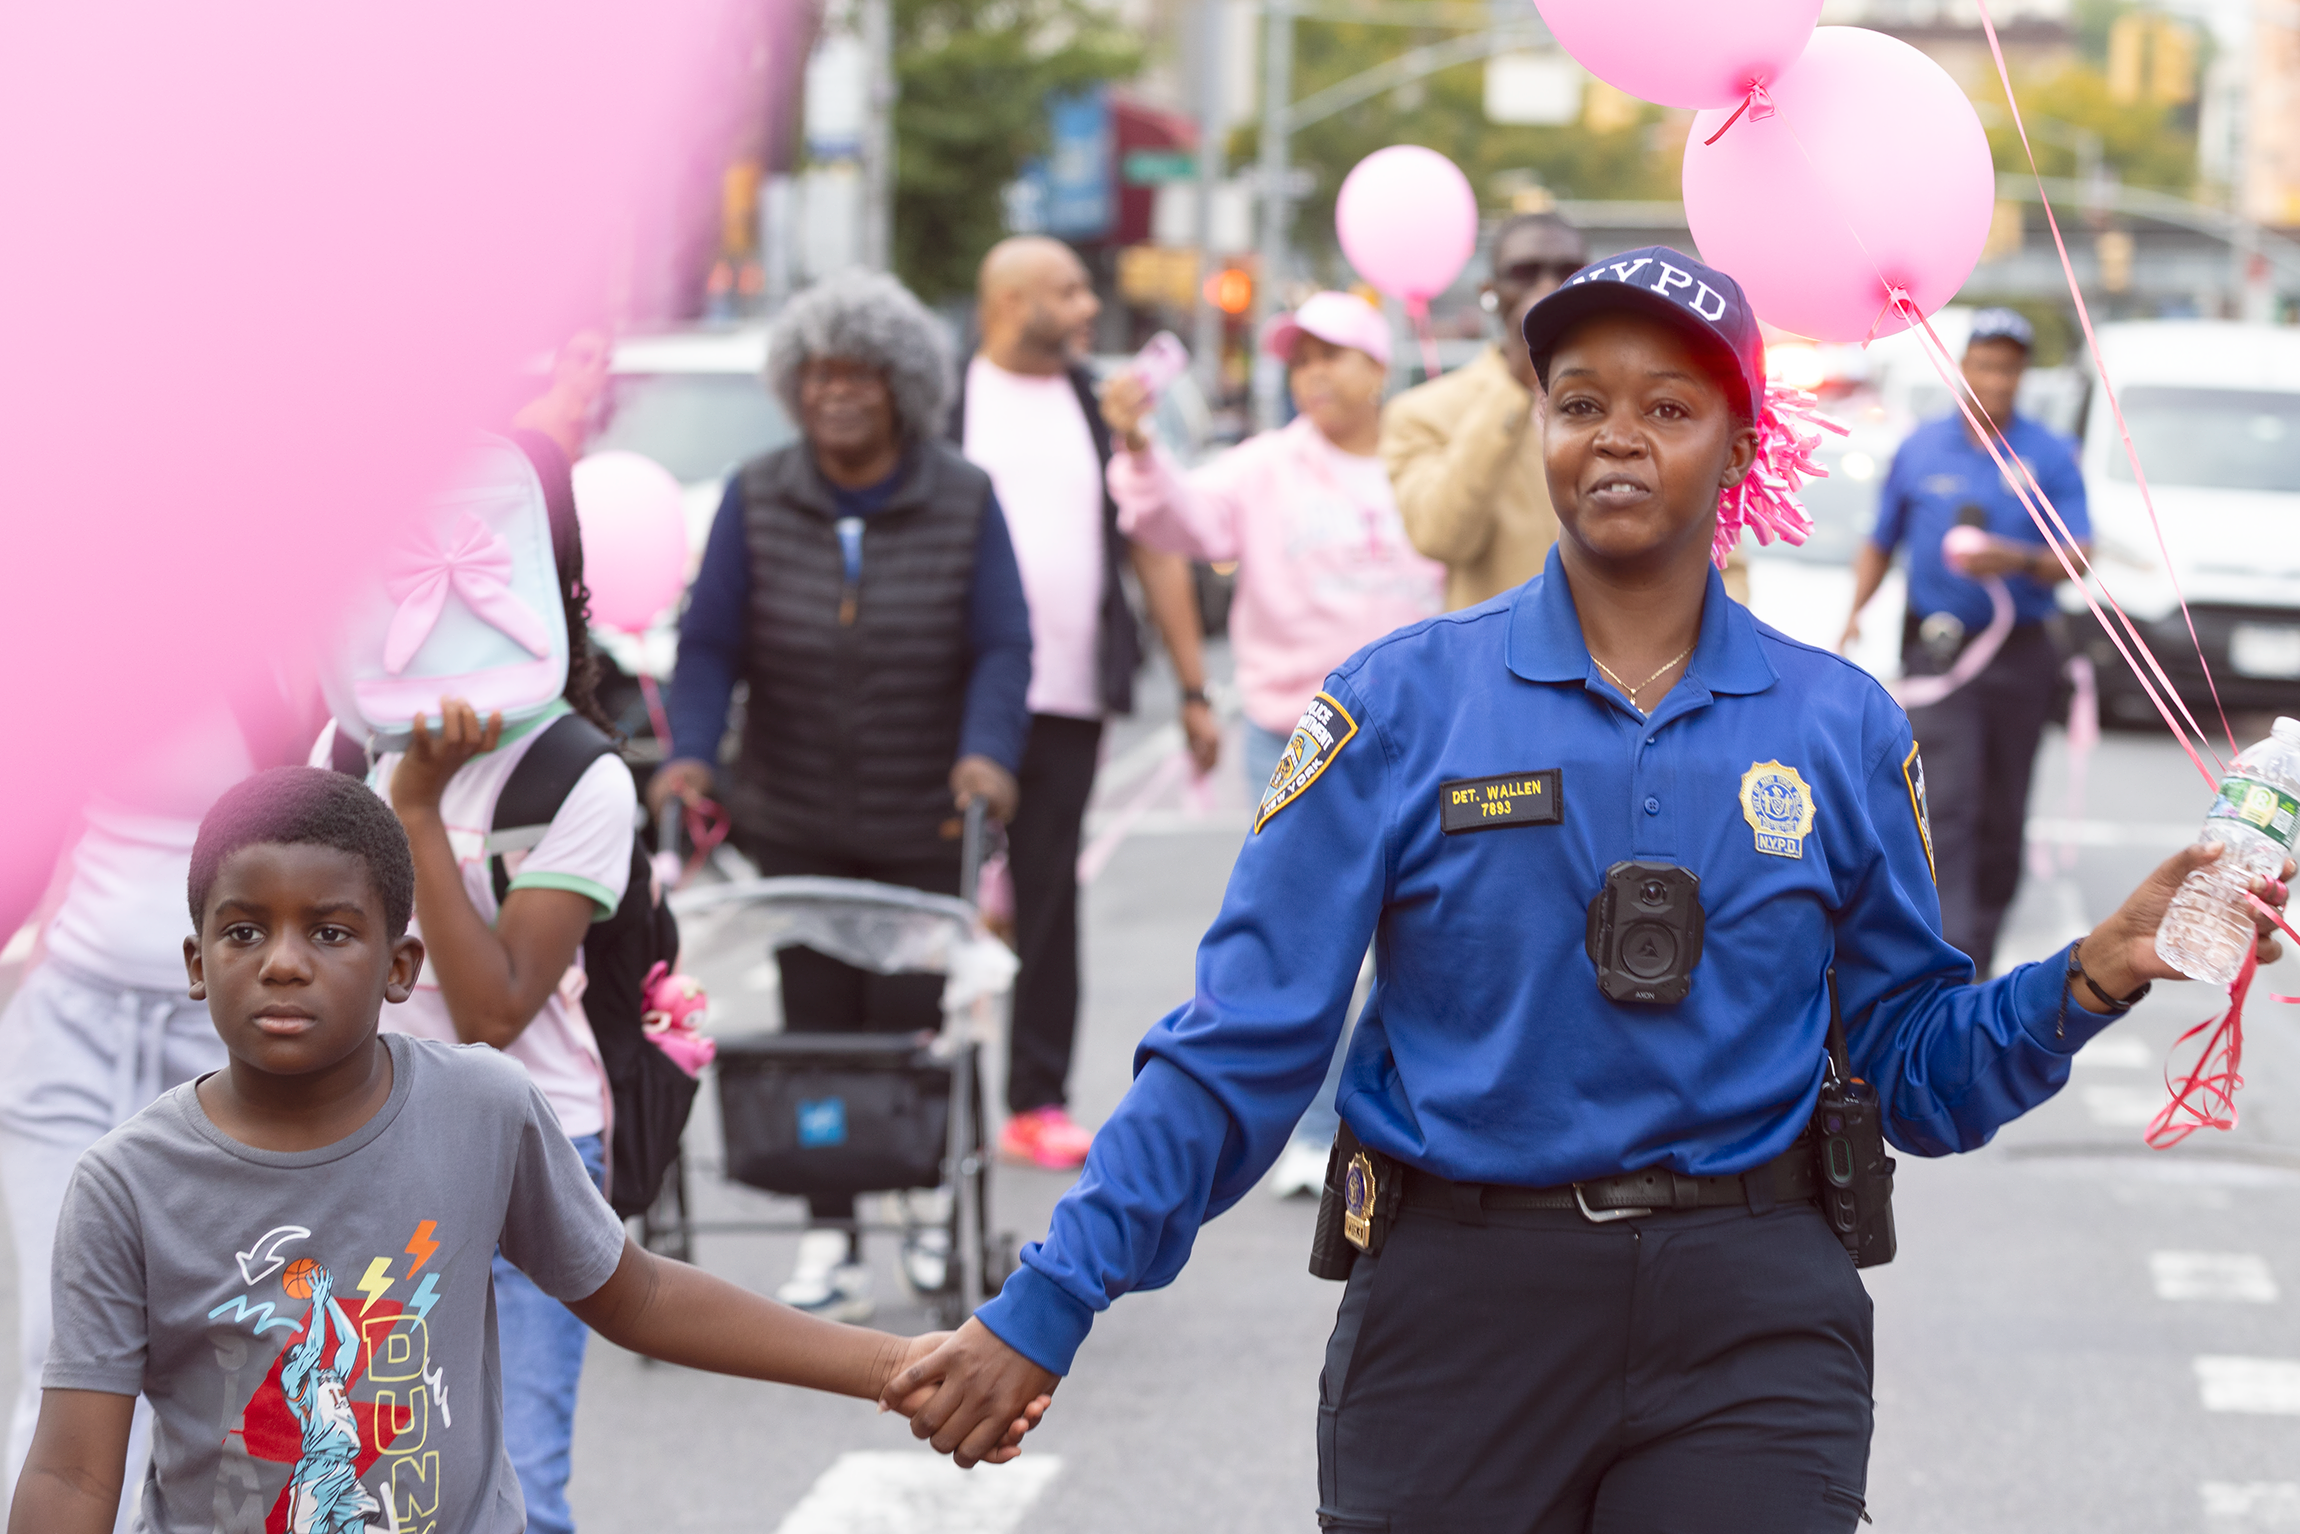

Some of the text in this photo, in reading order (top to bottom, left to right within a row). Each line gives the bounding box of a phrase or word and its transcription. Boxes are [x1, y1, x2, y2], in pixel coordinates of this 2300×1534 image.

[1263, 759, 1323, 816] NEW YORK
[1451, 780, 1542, 805] DET. WALLEN
[1480, 800, 1512, 818] 7893
[1759, 834, 1799, 854] N.Y.P.D.
[1635, 991, 1655, 1000] AXON
[361, 1314, 440, 1534] DUN
